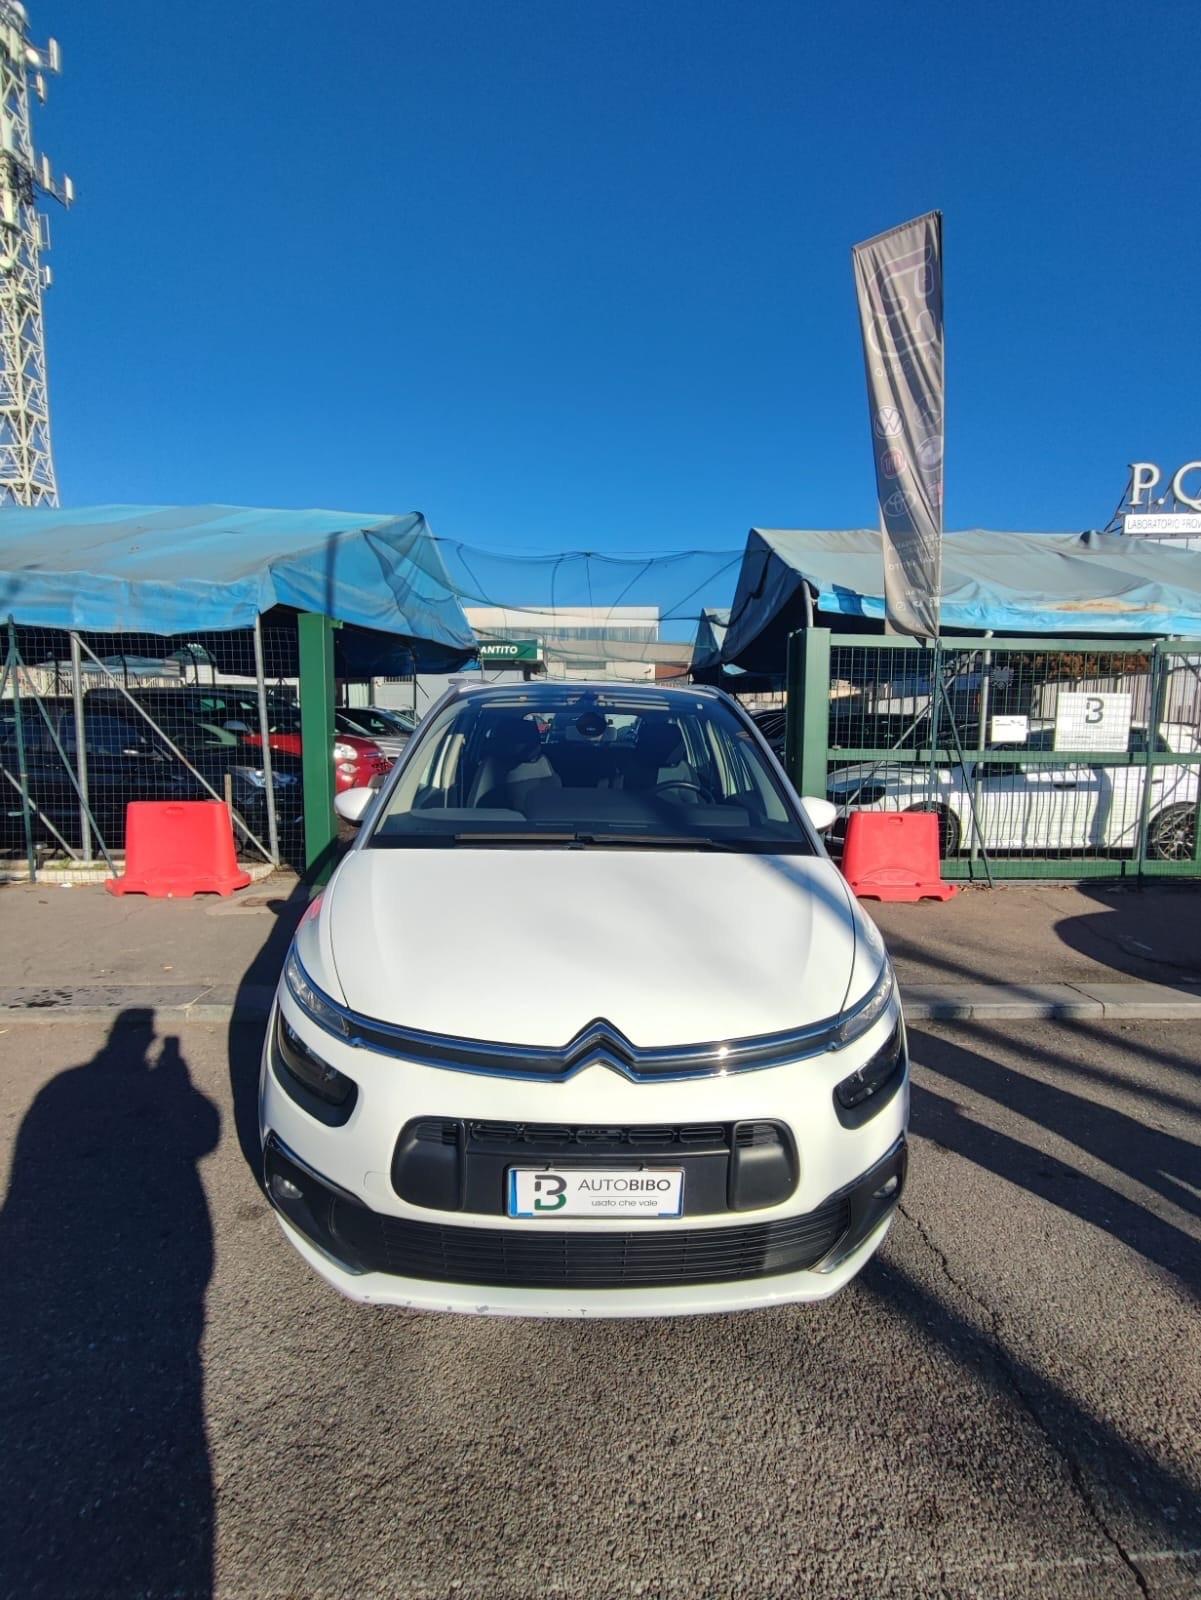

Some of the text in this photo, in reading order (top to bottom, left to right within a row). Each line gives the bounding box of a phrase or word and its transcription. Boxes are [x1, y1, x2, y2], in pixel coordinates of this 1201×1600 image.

[577, 1178, 672, 1192] AUTOBIBO
[591, 1198, 658, 1208] usato che vale
